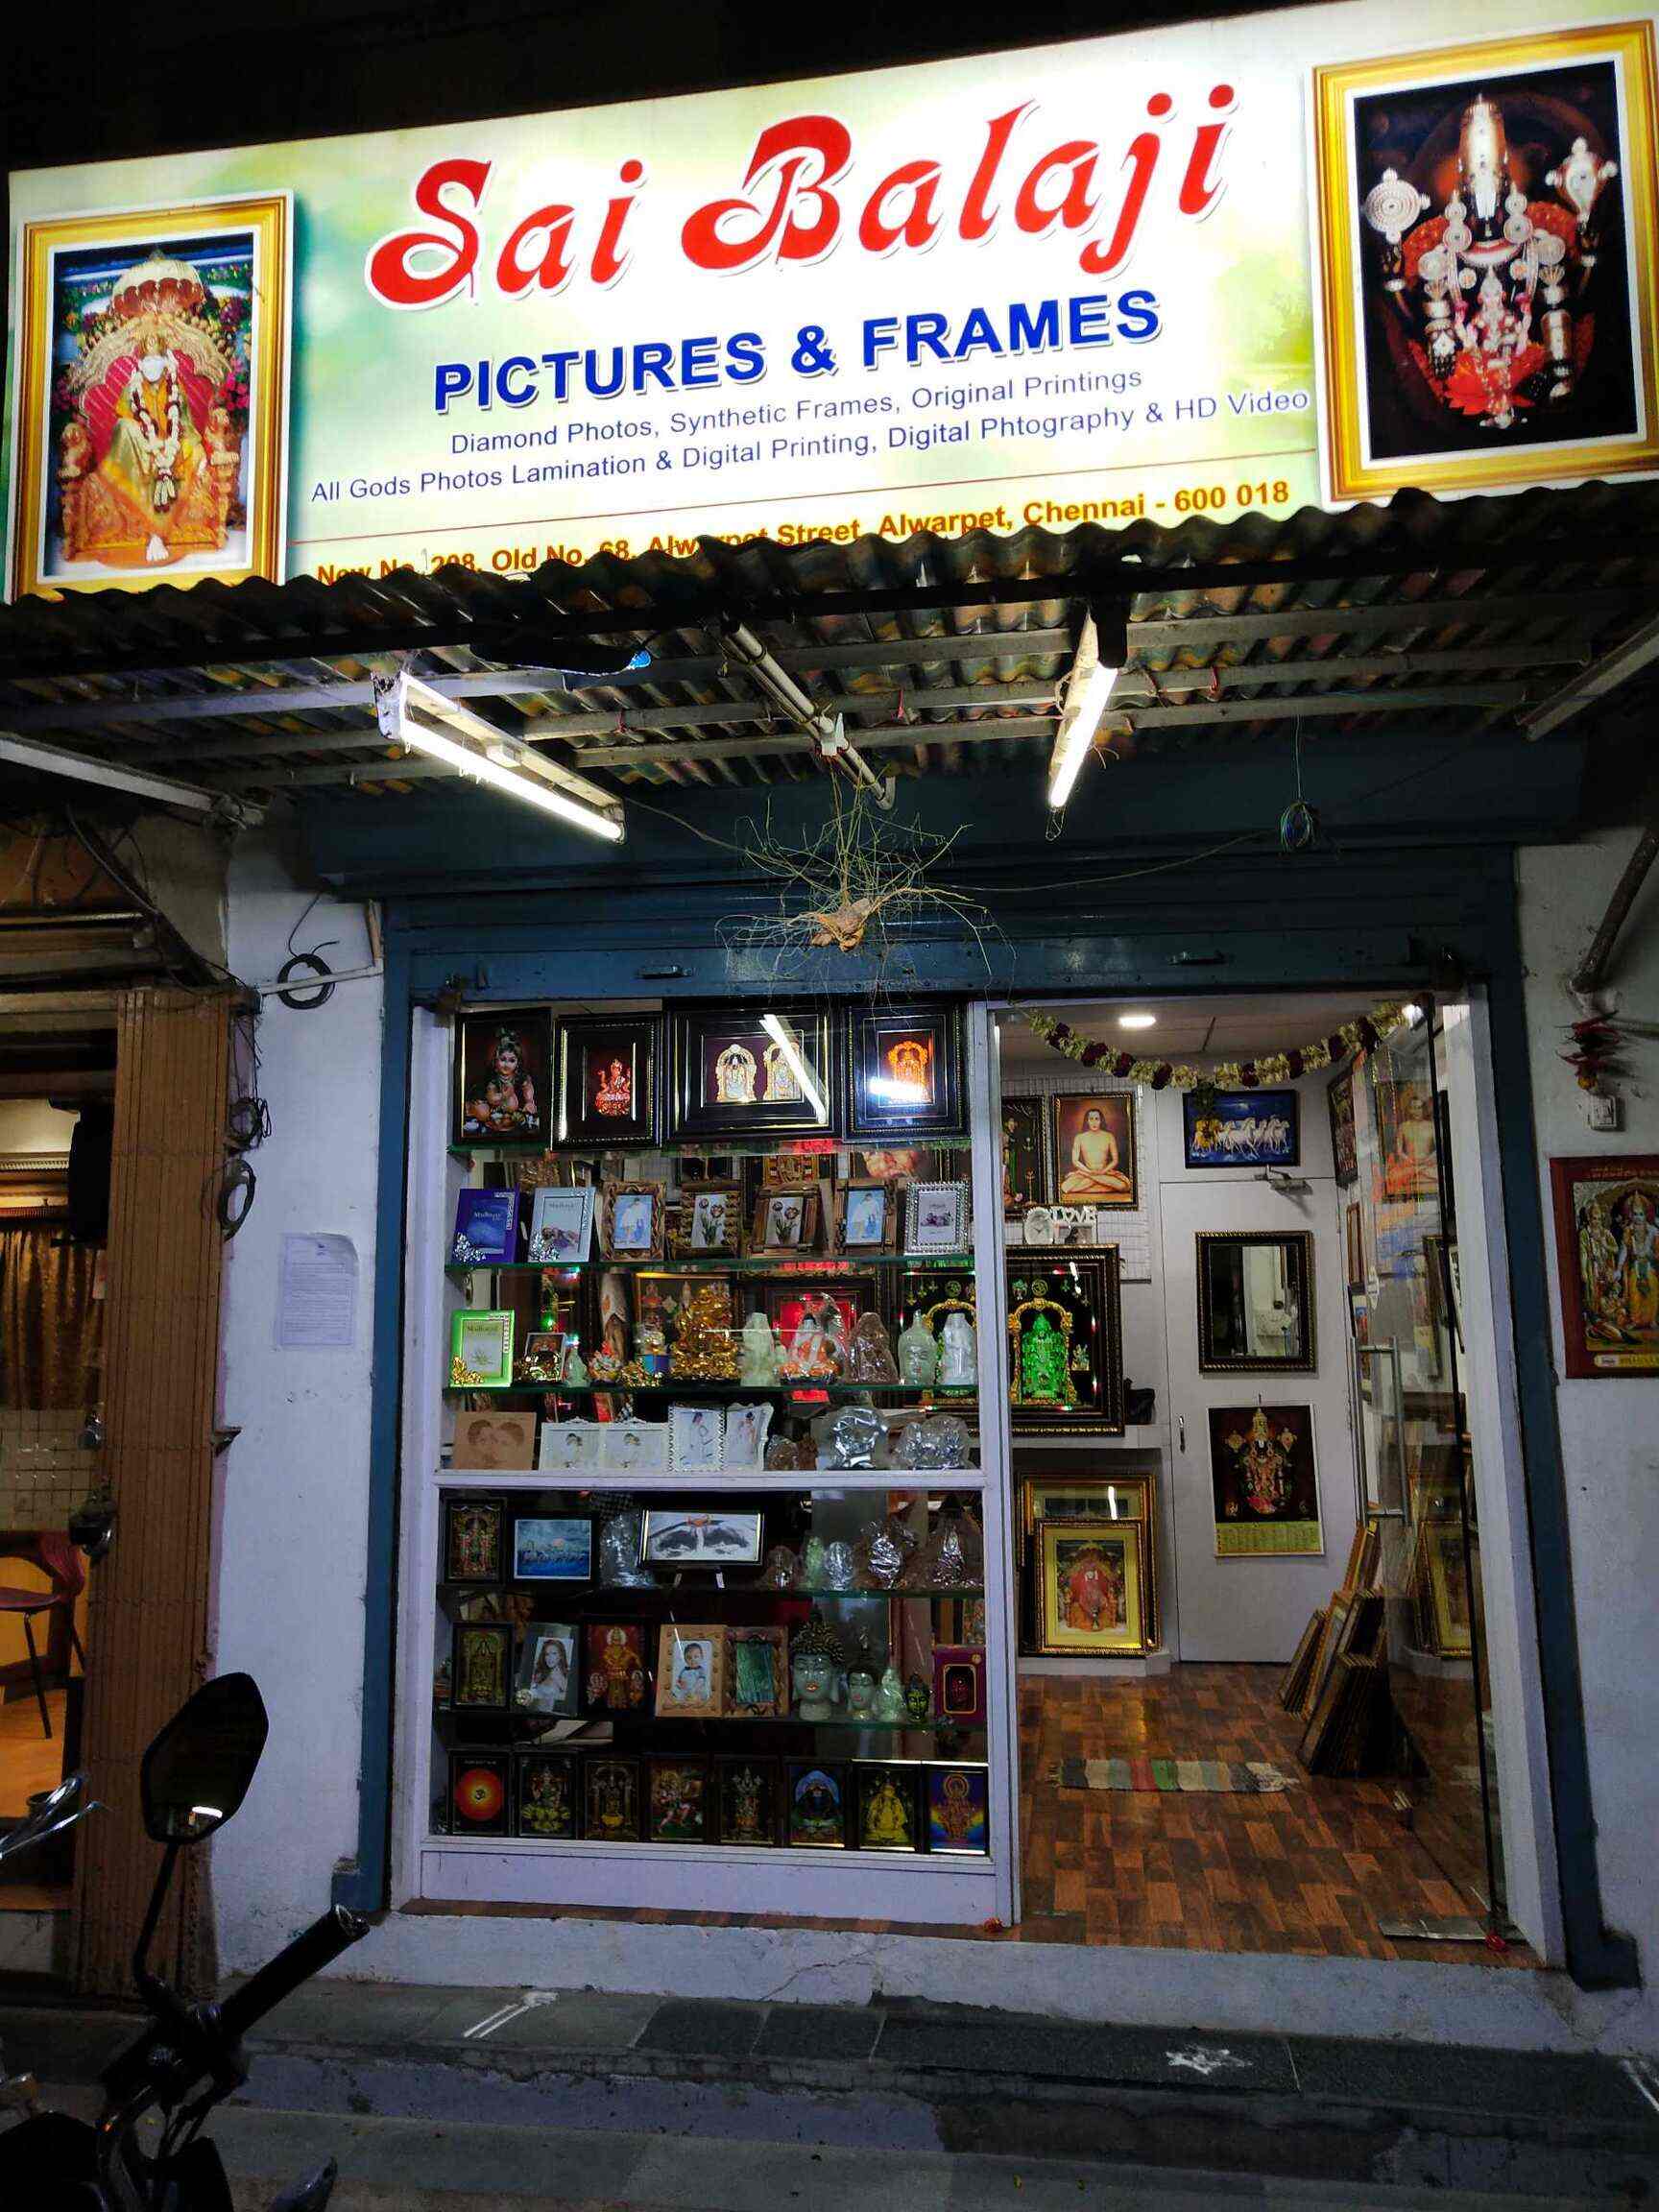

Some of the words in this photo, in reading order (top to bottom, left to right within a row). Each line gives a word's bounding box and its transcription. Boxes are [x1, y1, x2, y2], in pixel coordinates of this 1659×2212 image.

[371, 158, 644, 304] Sai
[681, 84, 1236, 275] Balaji
[435, 332, 764, 412] PICTURES
[791, 325, 836, 373] &
[863, 289, 1160, 367] FRAMES
[311, 481, 340, 502] All
[349, 476, 411, 498] Gods
[421, 470, 503, 493] Photos
[512, 455, 645, 485] Lamination
[656, 450, 673, 470] &
[683, 441, 760, 470] Digital
[772, 435, 878, 459] Printing,
[888, 420, 970, 451] Digital
[981, 406, 1135, 440] Phtography
[1145, 402, 1164, 423] &
[1175, 397, 1217, 421] HD
[1228, 391, 1308, 415] Video
[451, 425, 558, 454] Diamond
[567, 420, 660, 444] Photos,
[670, 405, 786, 437] Synthetic
[797, 397, 901, 421] Frames,
[911, 380, 1013, 411] Original
[1024, 372, 1142, 398] Printings
[492, 546, 537, 571] Old
[1022, 493, 1145, 525] Chennai
[1173, 486, 1227, 511] 600
[1236, 480, 1289, 506] 018
